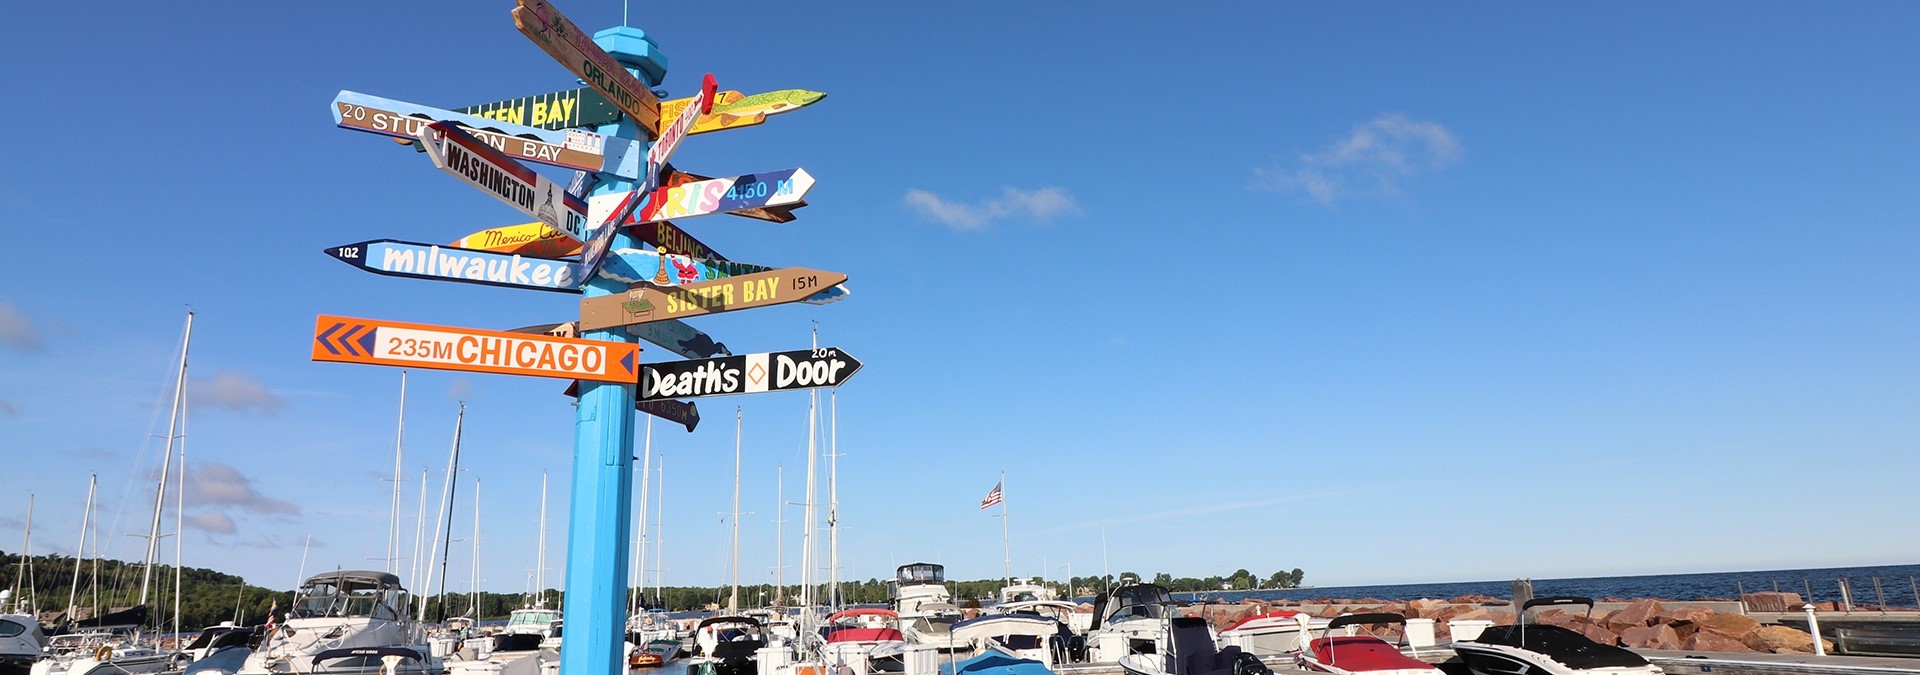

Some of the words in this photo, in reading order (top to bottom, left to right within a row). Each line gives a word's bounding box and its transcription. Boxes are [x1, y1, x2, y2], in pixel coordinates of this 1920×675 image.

[583, 60, 640, 115] ORLANDO
[718, 92, 727, 104] 7
[533, 98, 576, 126] BAY
[342, 104, 366, 121] 20
[523, 141, 562, 162] BAY
[447, 142, 536, 212] WASHINGTON
[566, 210, 580, 236] DC
[726, 181, 768, 201] 4150
[777, 177, 794, 196] M
[485, 230, 536, 248] Mexico
[657, 220, 705, 259] BEIJING
[338, 247, 359, 259] 102
[382, 245, 574, 287] milwaukee
[667, 286, 734, 314] SISTER
[743, 276, 780, 303] BAY
[792, 275, 818, 290] 15M
[388, 336, 453, 360] 235M
[455, 335, 602, 372] CHICAGO
[642, 360, 741, 399] Death's
[775, 353, 846, 389] Door
